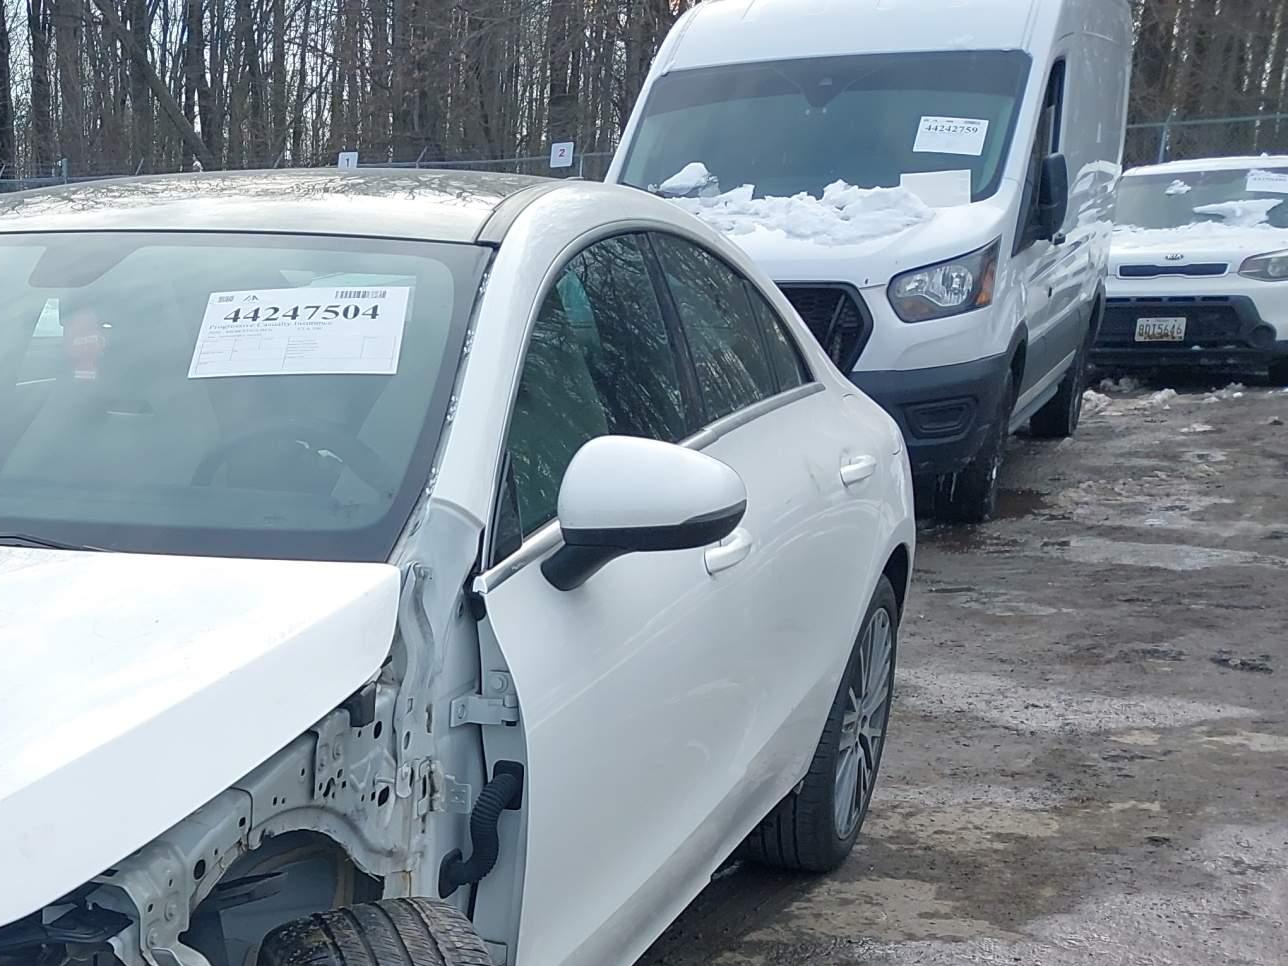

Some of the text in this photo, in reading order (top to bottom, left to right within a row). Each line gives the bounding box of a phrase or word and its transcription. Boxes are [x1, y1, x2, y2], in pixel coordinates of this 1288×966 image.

[924, 124, 979, 134] 44242759
[558, 148, 566, 158] 2
[222, 303, 381, 323] 44247504
